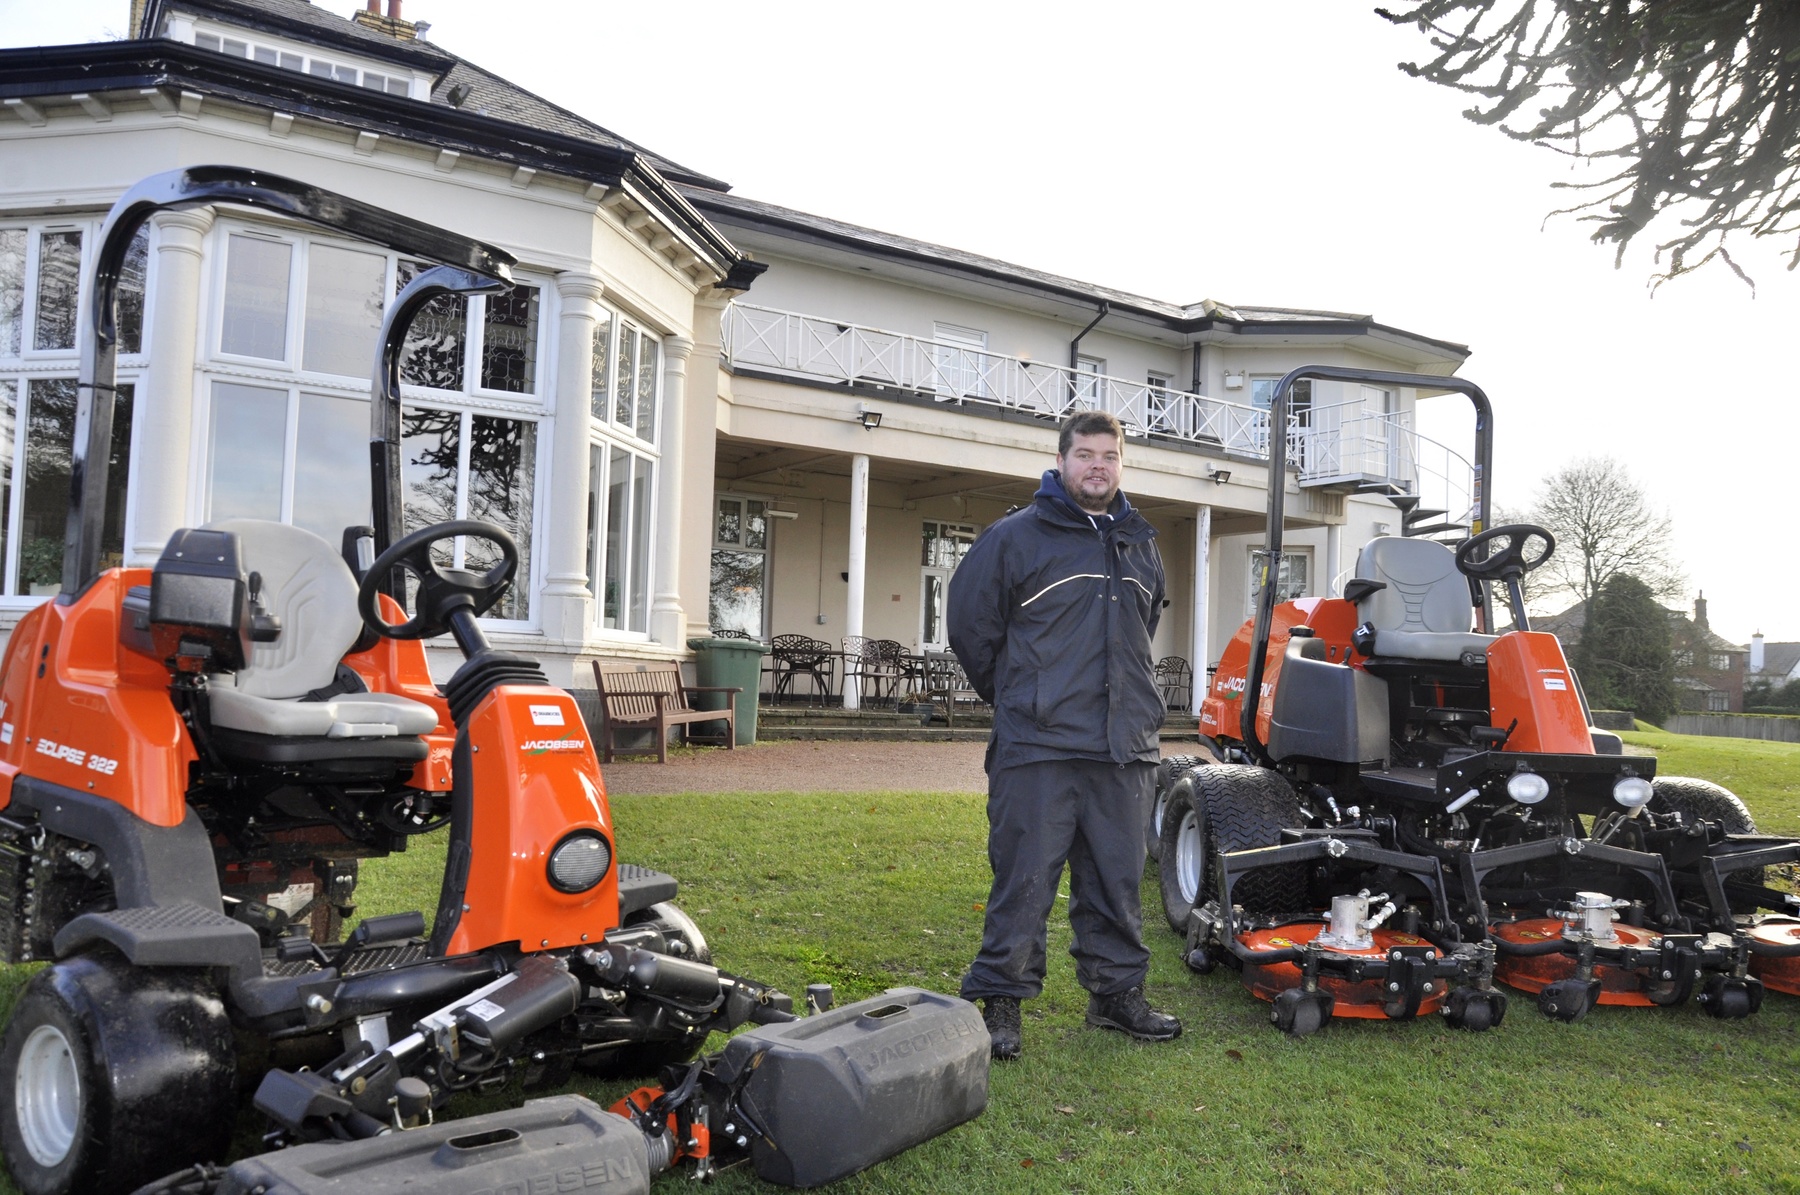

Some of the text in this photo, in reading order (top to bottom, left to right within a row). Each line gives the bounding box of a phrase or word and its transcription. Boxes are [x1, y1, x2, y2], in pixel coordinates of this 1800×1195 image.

[1224, 676, 1273, 698] JACON
[35, 738, 118, 776] ECLIPSE 322
[520, 740, 585, 750] JACOBSEN
[470, 1156, 632, 1195] OBSEN
